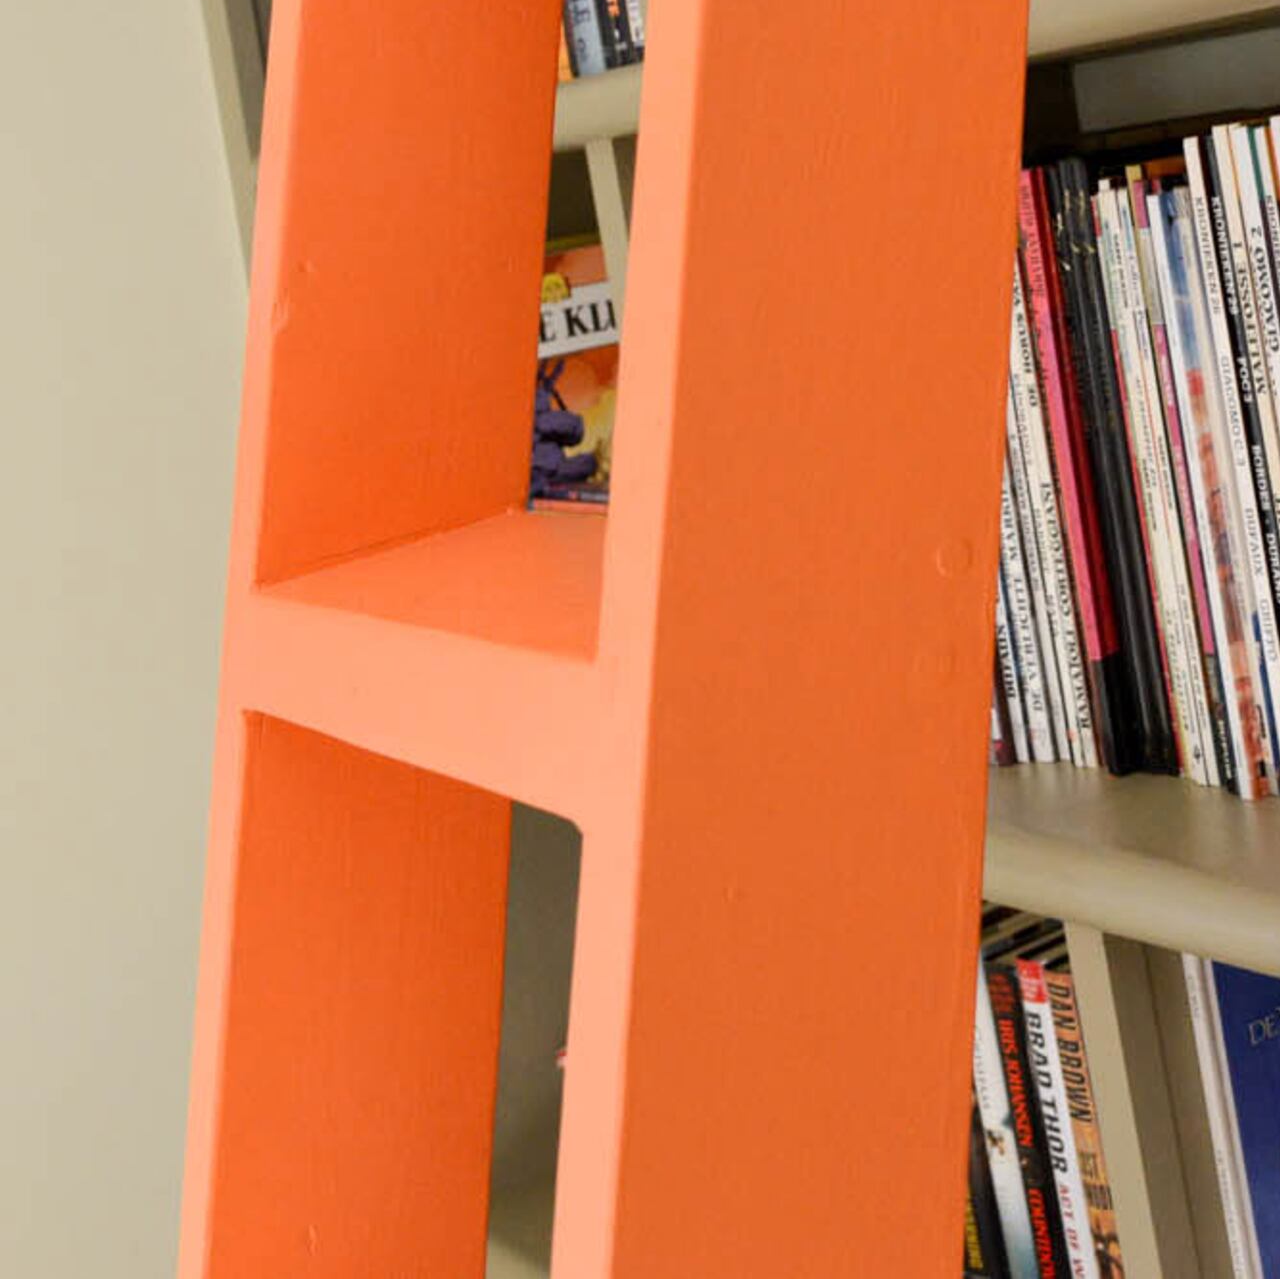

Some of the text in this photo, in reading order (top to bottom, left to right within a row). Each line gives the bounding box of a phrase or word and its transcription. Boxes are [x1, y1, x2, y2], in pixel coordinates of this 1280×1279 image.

[1250, 225, 1262, 238] 2
[1235, 260, 1267, 394] MALEFOSSE
[1253, 245, 1280, 352] GIACOMO
[1045, 979, 1077, 1034] DAN
[1023, 1009, 1054, 1091] BRAD
[1039, 1095, 1069, 1175] THOR
[1055, 1034, 1094, 1126] BROWN
